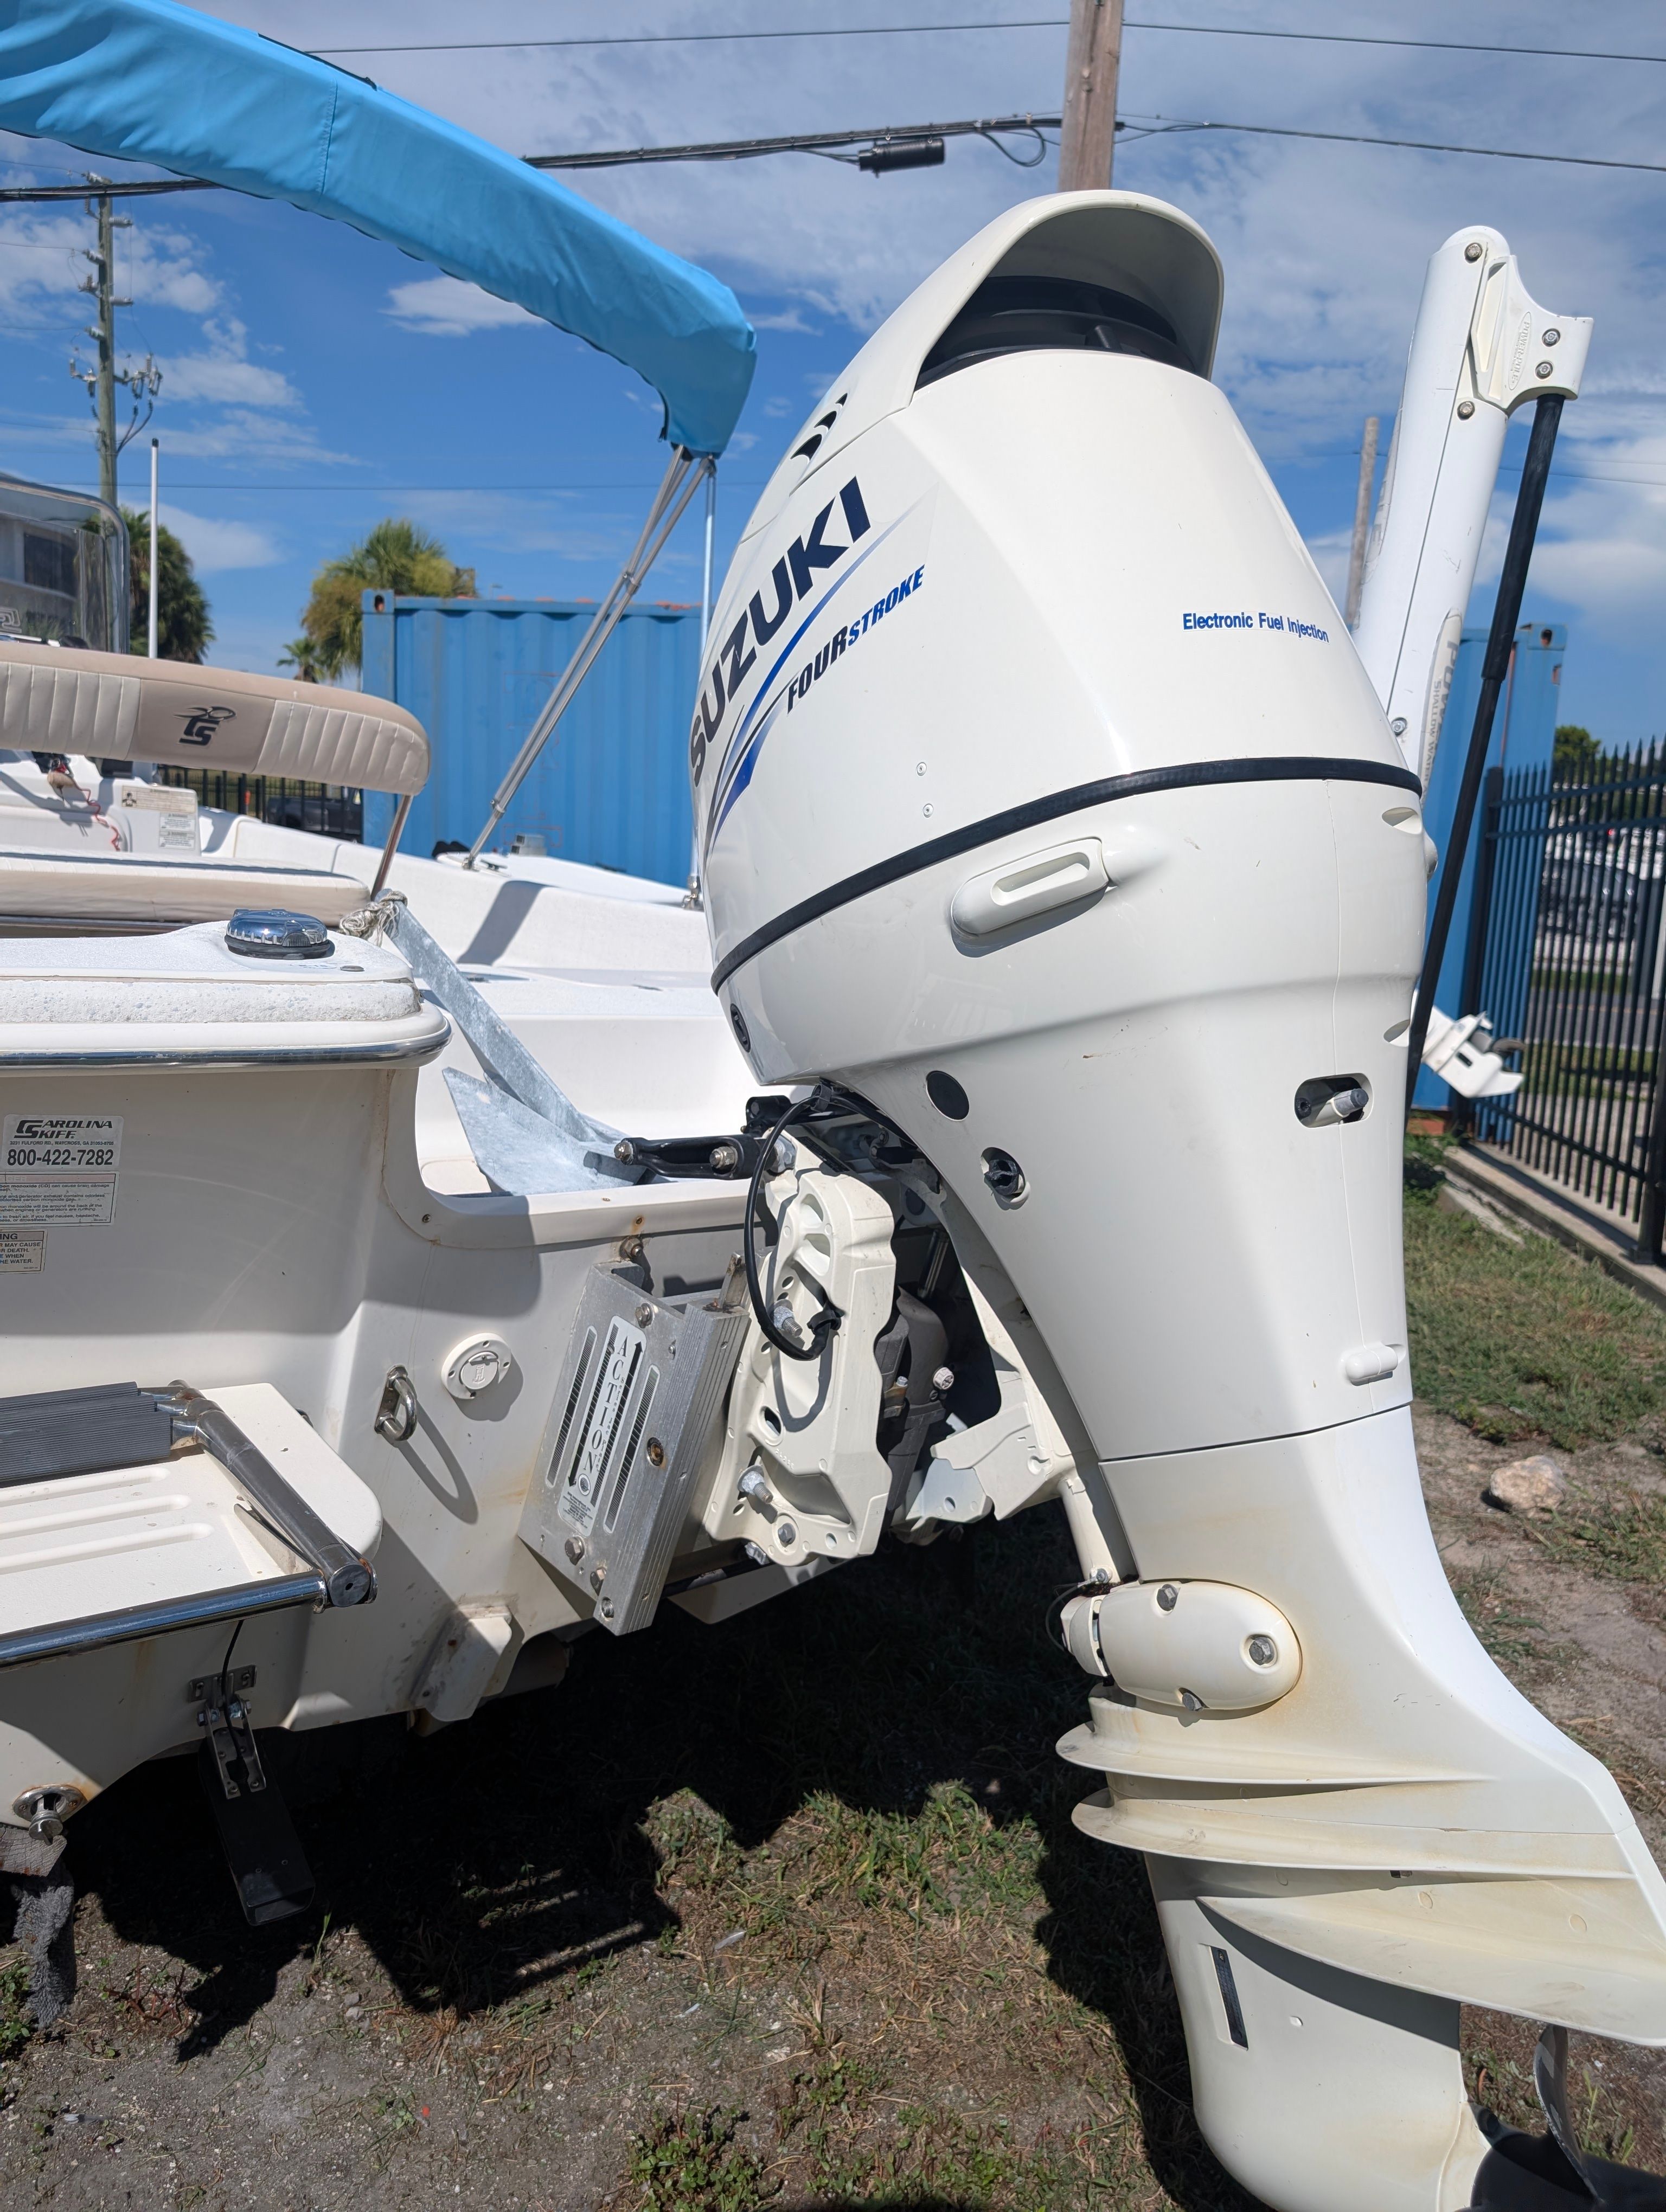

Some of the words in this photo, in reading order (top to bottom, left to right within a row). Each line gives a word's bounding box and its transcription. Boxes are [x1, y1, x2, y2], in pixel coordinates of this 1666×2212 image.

[691, 475, 872, 787] SUZUKI
[1183, 612, 1254, 630] Electronic
[1258, 612, 1285, 631] Fuel
[1286, 617, 1330, 643] Injection
[1429, 680, 1441, 737] SHALLOW
[16, 1120, 113, 1134] CAROLINA
[7, 1148, 114, 1166] 800-422-7282
[582, 1335, 627, 1474] ACTION
